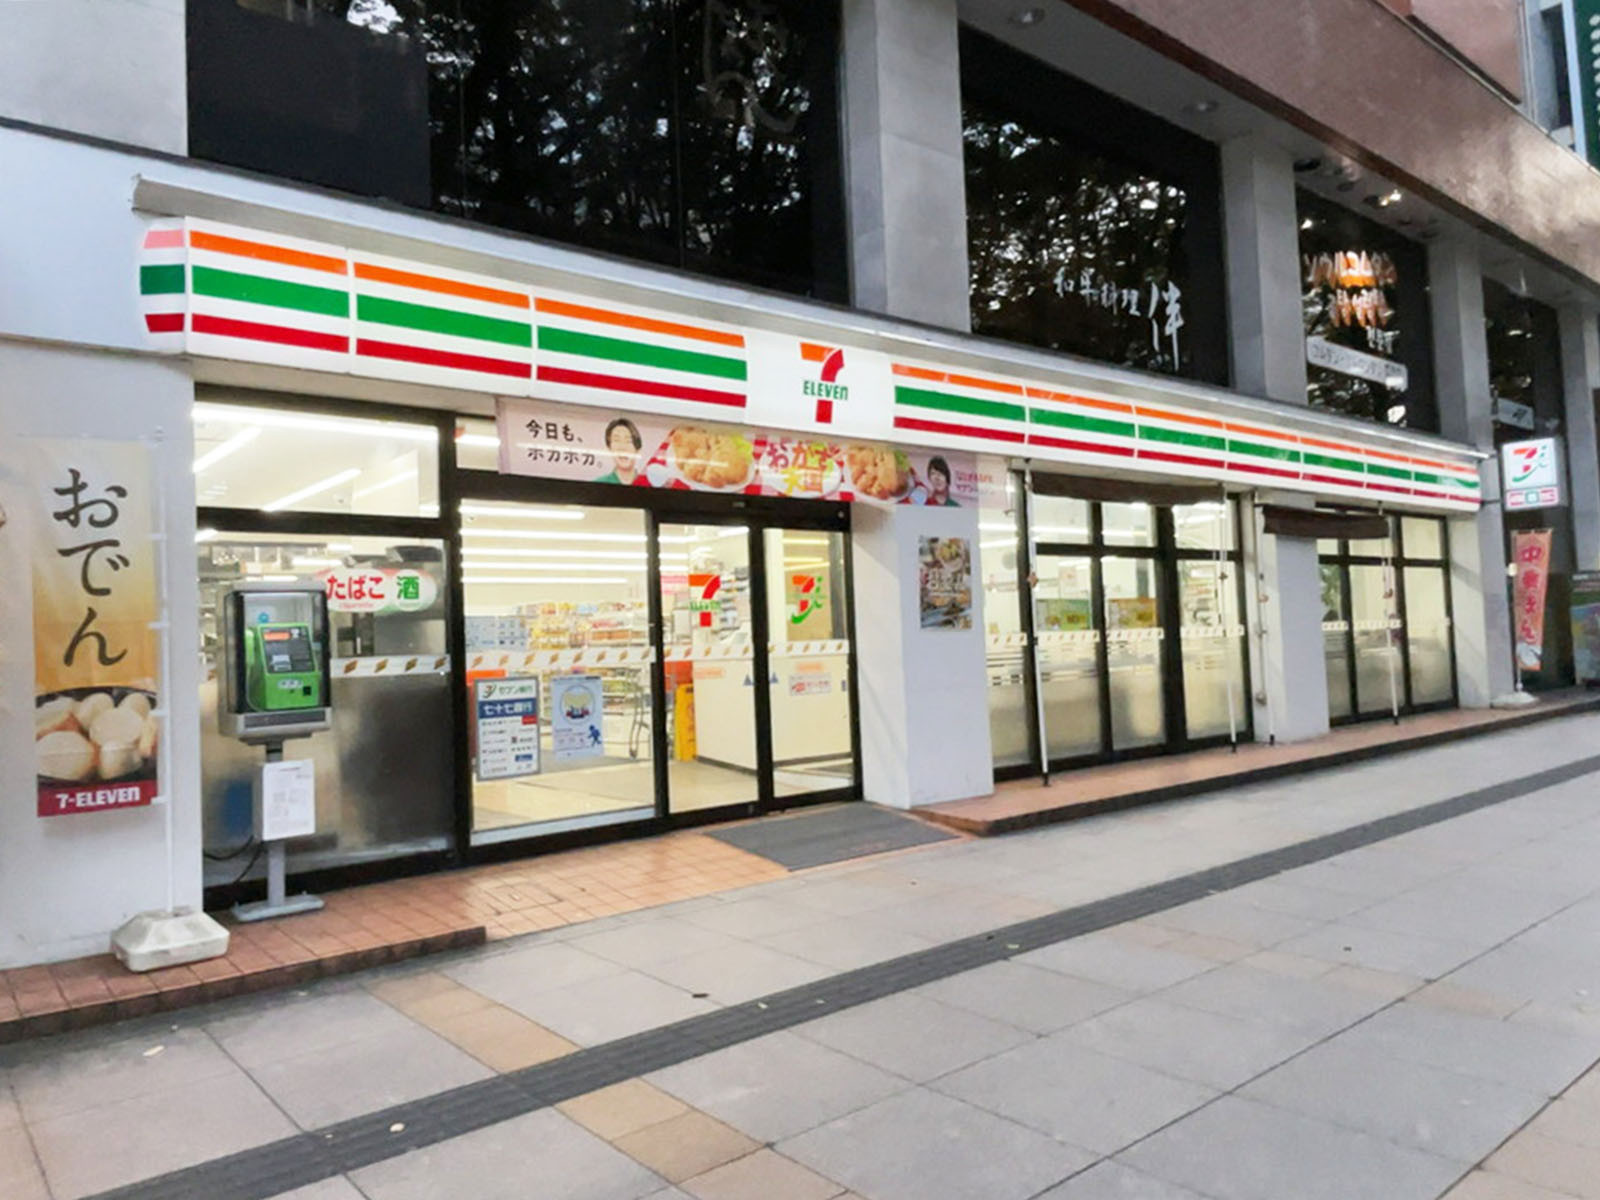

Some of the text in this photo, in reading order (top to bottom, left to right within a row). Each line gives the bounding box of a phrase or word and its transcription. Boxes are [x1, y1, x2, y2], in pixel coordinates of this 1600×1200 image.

[526, 418, 584, 444] 今日も、
[53, 468, 130, 667] おでん
[327, 575, 420, 600] たばこ 酒
